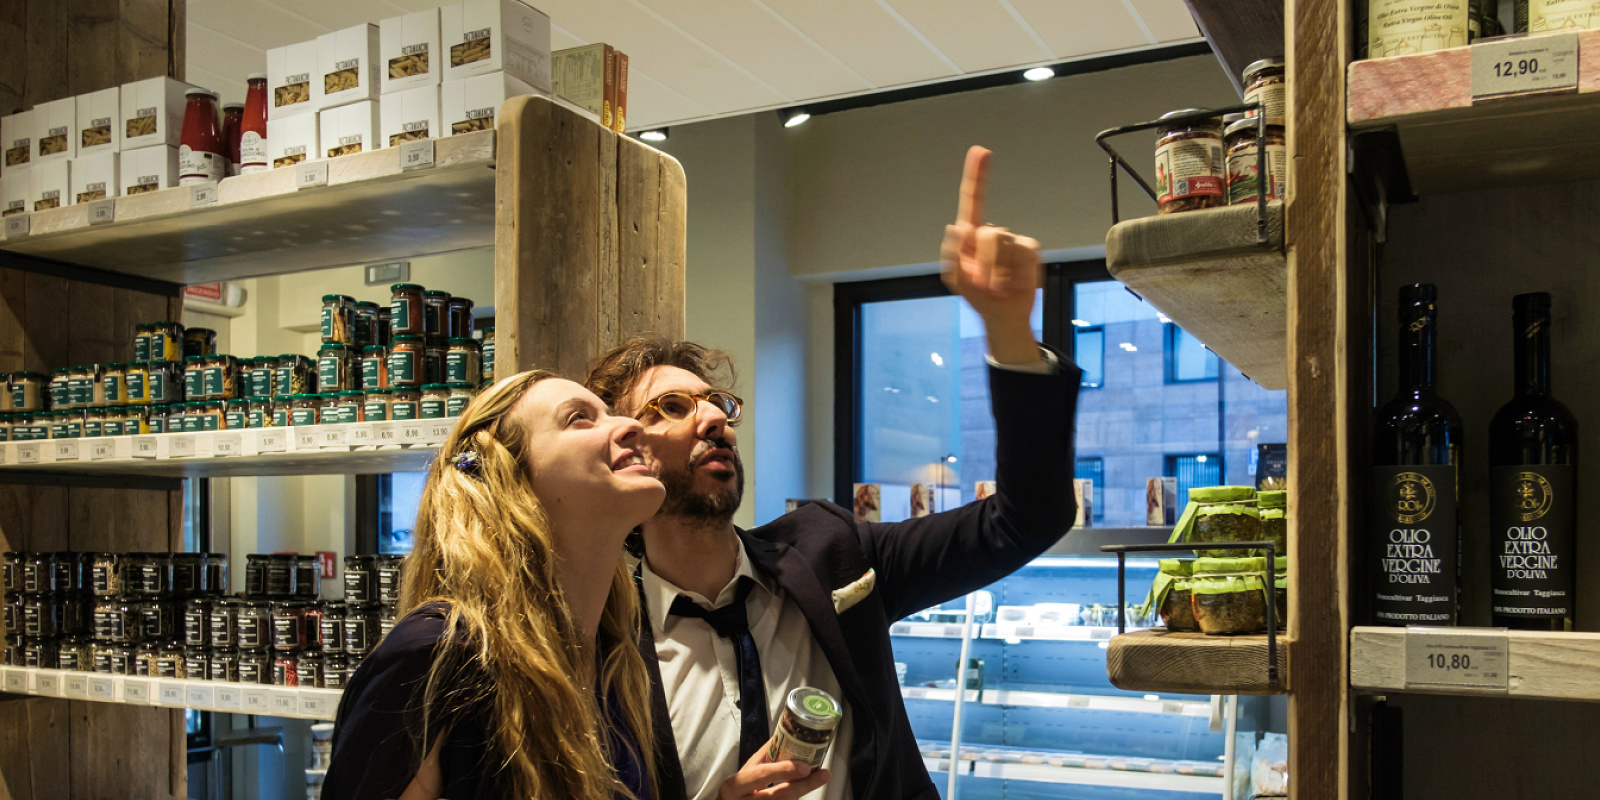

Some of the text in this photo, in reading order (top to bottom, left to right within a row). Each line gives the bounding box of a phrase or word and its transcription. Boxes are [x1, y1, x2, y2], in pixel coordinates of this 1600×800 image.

[1493, 58, 1538, 78] 12,90
[1389, 529, 1431, 544] OLIO
[1507, 526, 1547, 541] OLIO
[1387, 544, 1434, 559] EXTRA
[1504, 541, 1551, 555] EXTRA
[1381, 559, 1441, 574] VERGINE
[1499, 555, 1558, 570] VERGINE
[1389, 575, 1431, 584] D'OLIVA
[1506, 569, 1548, 579] D'OLIVA
[1415, 594, 1449, 604] Taggiasca
[1533, 589, 1566, 598] Taggiasca
[1386, 612, 1419, 620] PRODOTTO
[1419, 613, 1450, 621] ITALIANO
[1536, 607, 1567, 615] ITALIANO
[1426, 653, 1470, 671] 10,80
